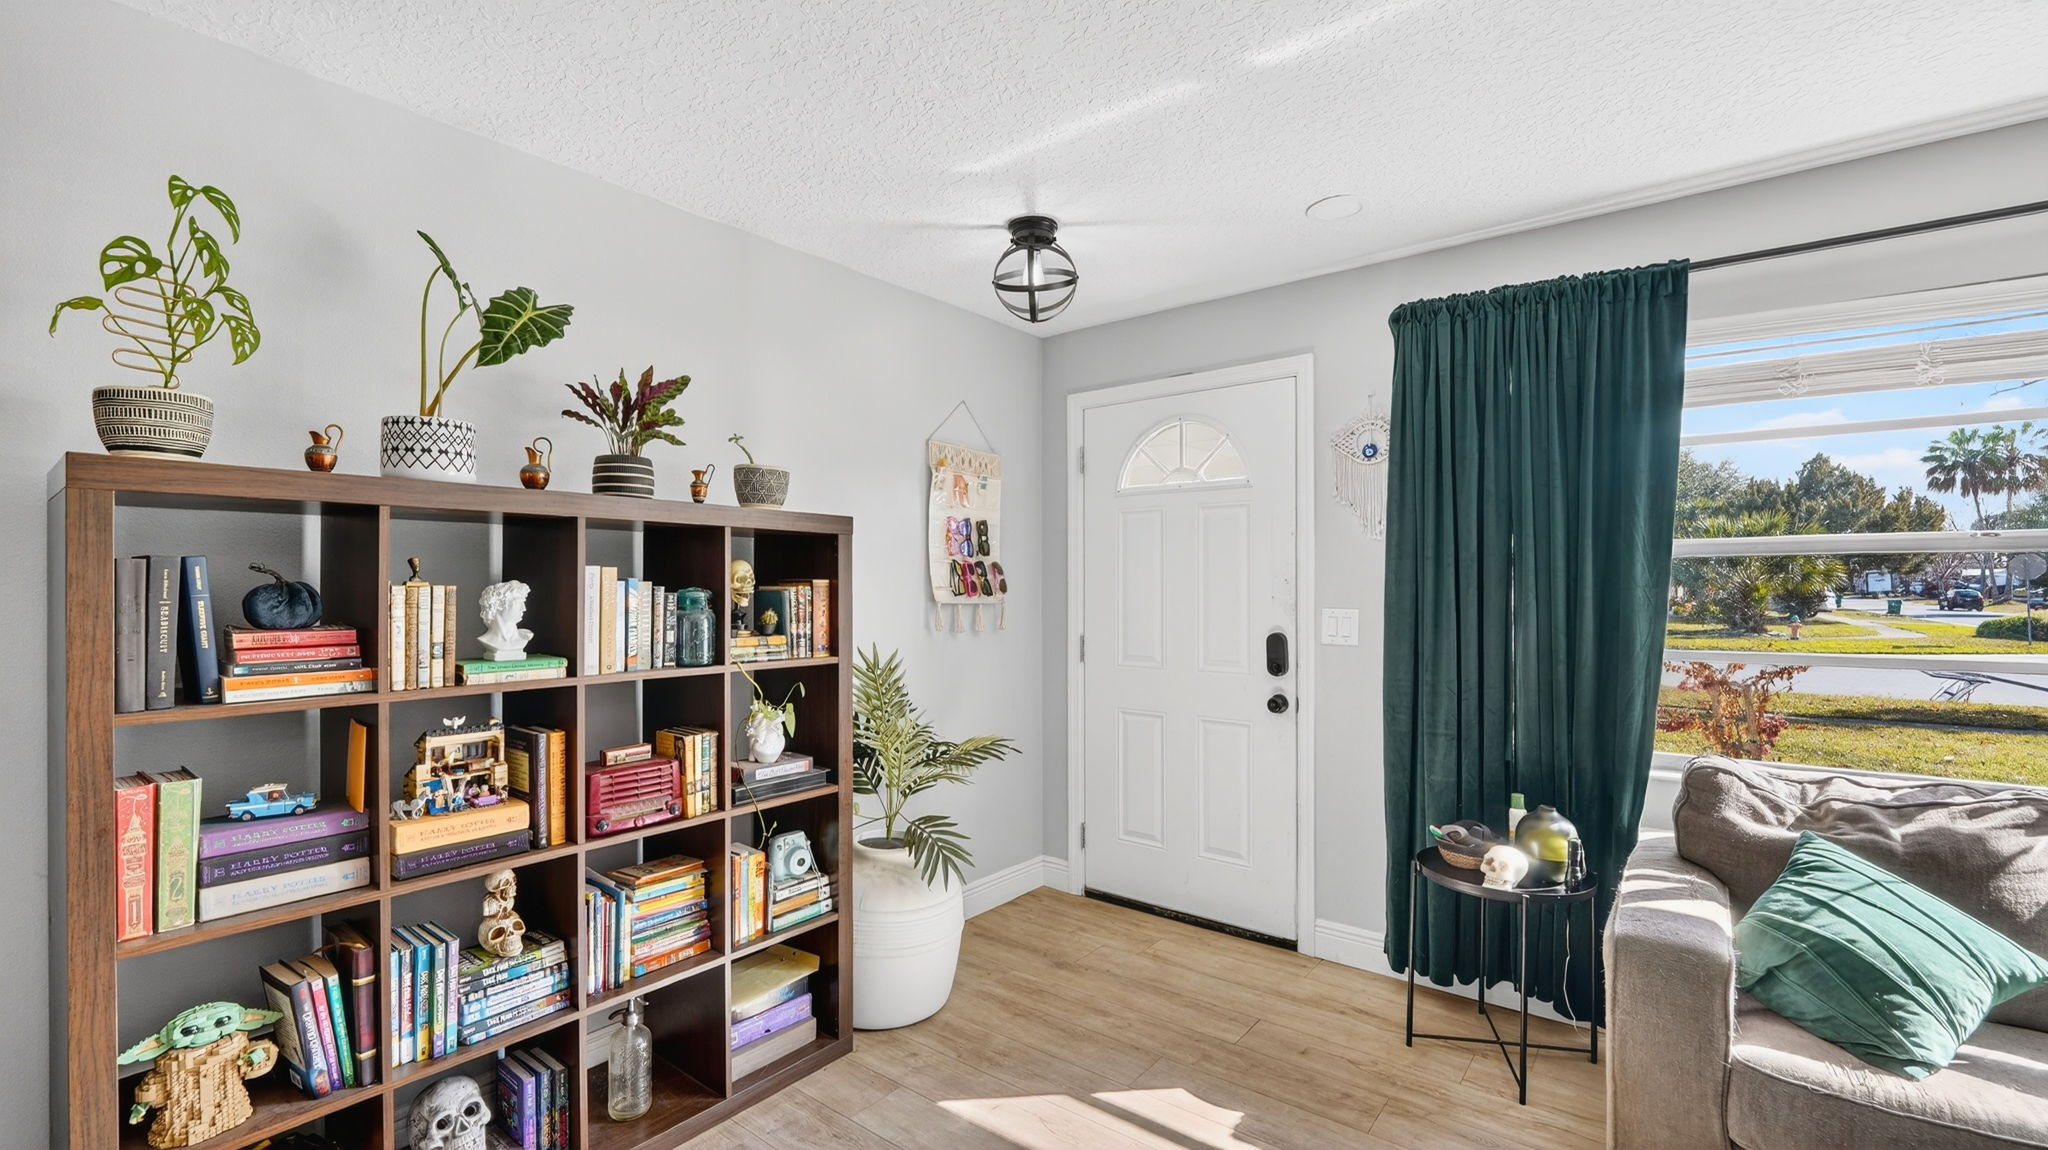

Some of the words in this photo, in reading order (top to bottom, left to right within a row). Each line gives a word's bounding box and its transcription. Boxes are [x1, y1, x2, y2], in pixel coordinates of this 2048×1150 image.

[232, 828, 279, 842] HARRY
[231, 855, 279, 870] HARRY
[283, 846, 328, 860] POTTER
